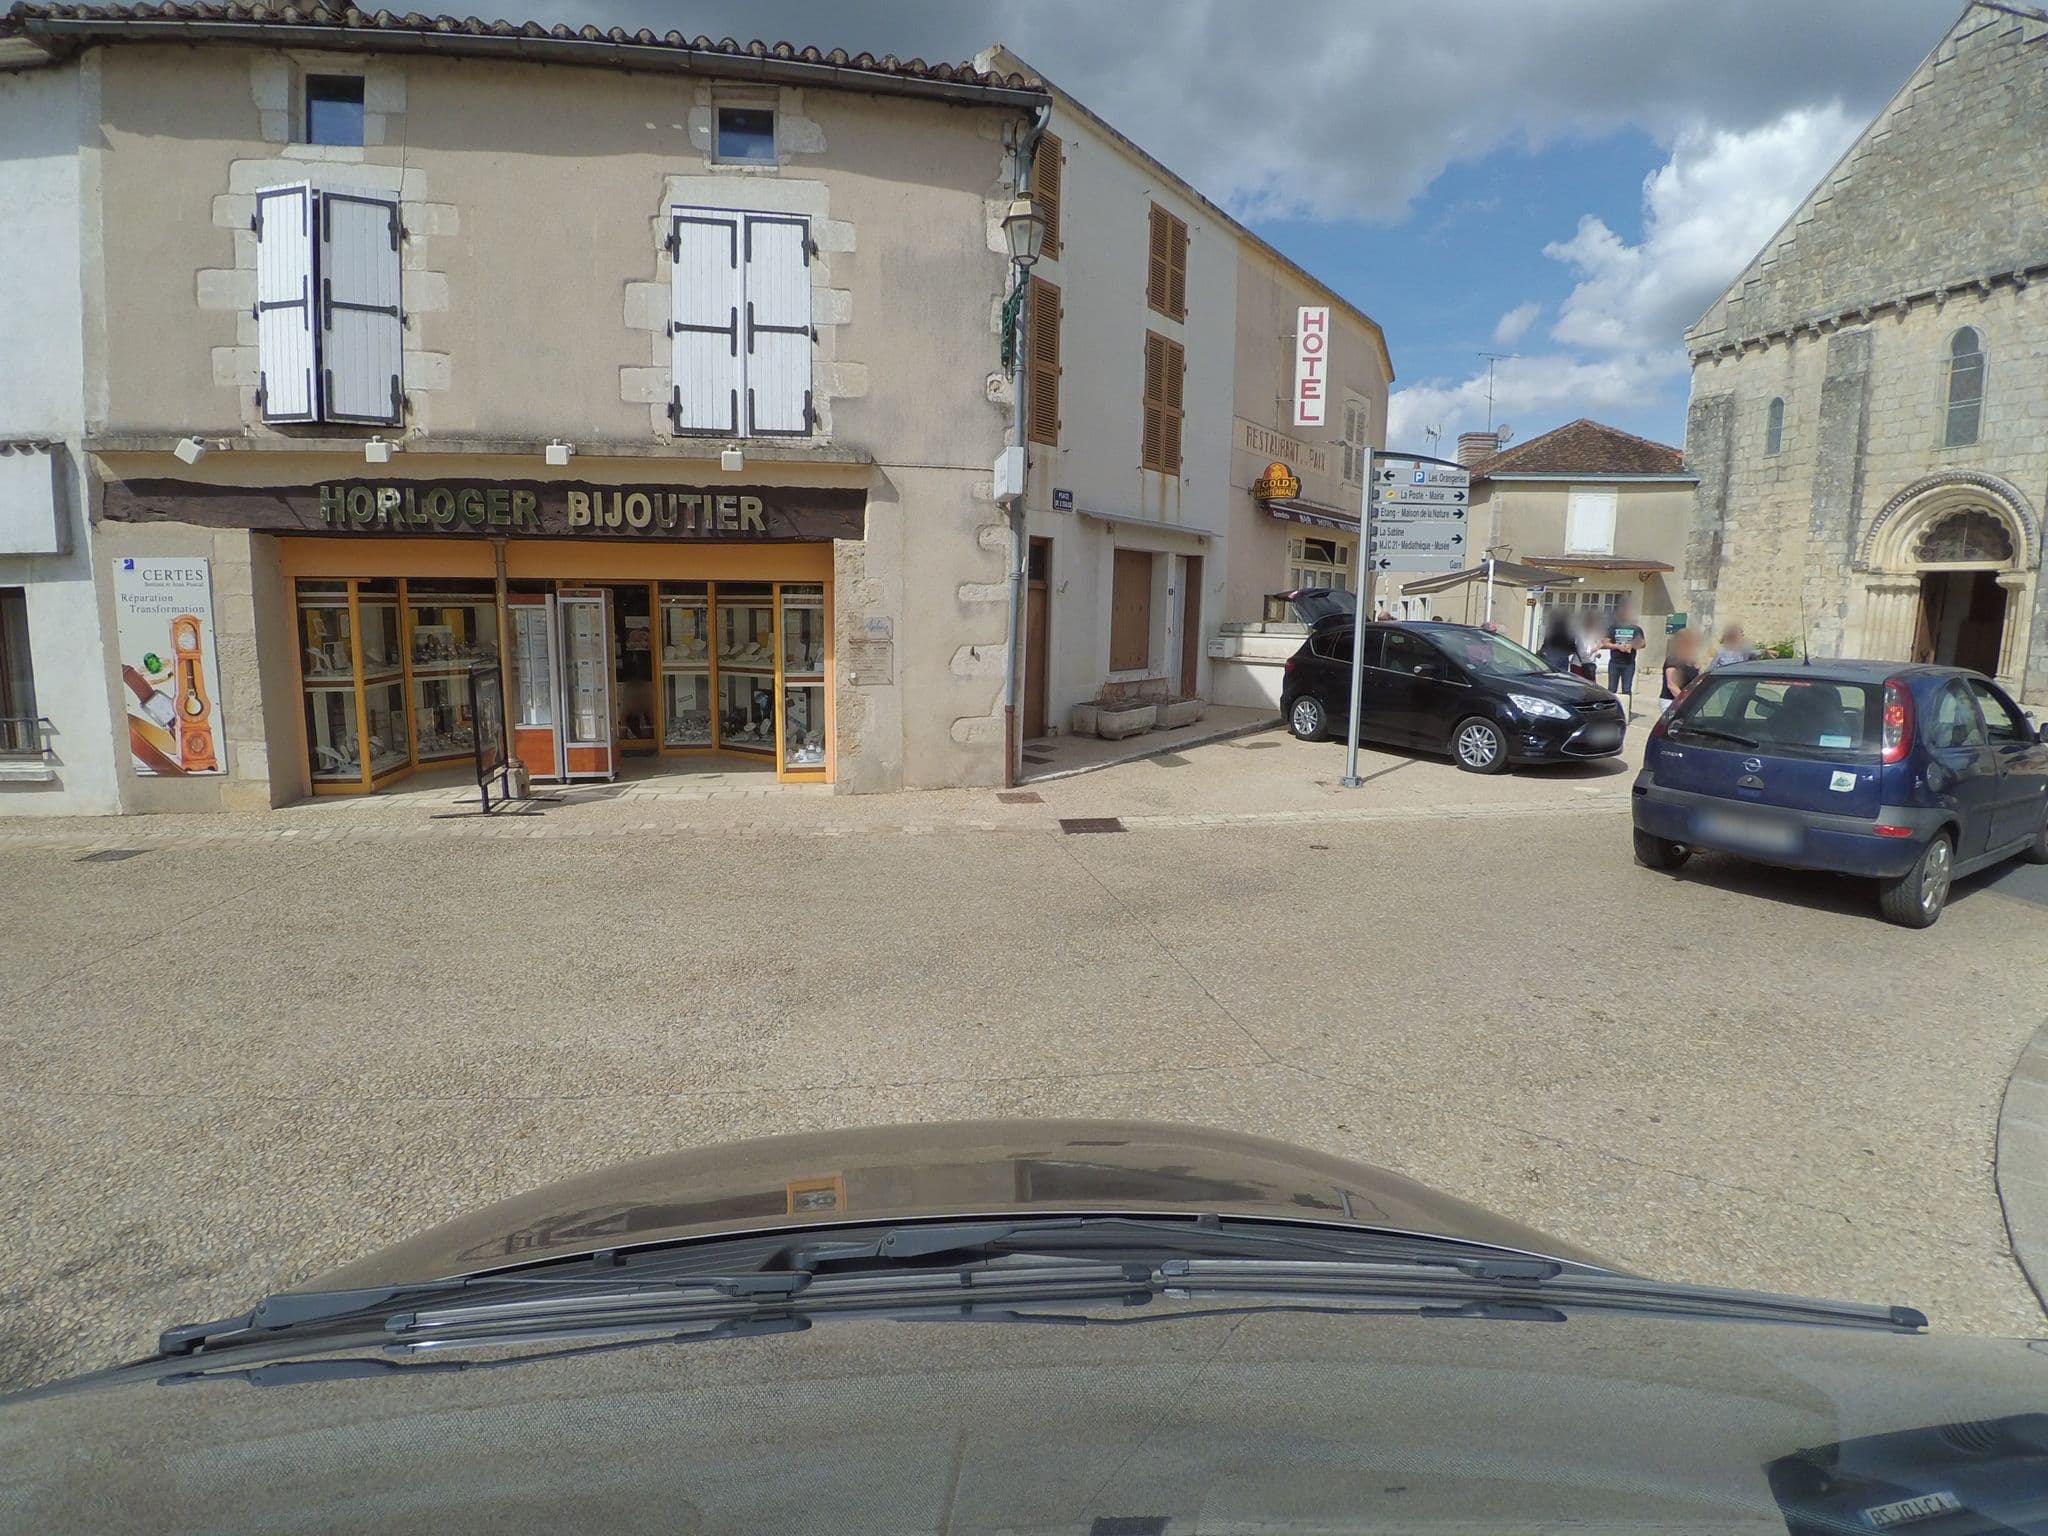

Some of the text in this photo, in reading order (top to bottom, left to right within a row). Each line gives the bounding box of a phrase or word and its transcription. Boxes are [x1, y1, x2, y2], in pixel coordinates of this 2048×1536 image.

[1299, 311, 1324, 421] HOTEL
[1246, 425, 1299, 462] RESTAURANT
[1428, 473, 1438, 482] Les
[1262, 479, 1289, 488] GOLD
[1408, 491, 1424, 499] Poste
[319, 485, 768, 532] HORLOGER BIJOUTIER
[1401, 508, 1420, 517] Maison
[142, 569, 204, 582] CERTES
[121, 593, 174, 604] Réparation
[129, 605, 205, 614] Transformation
